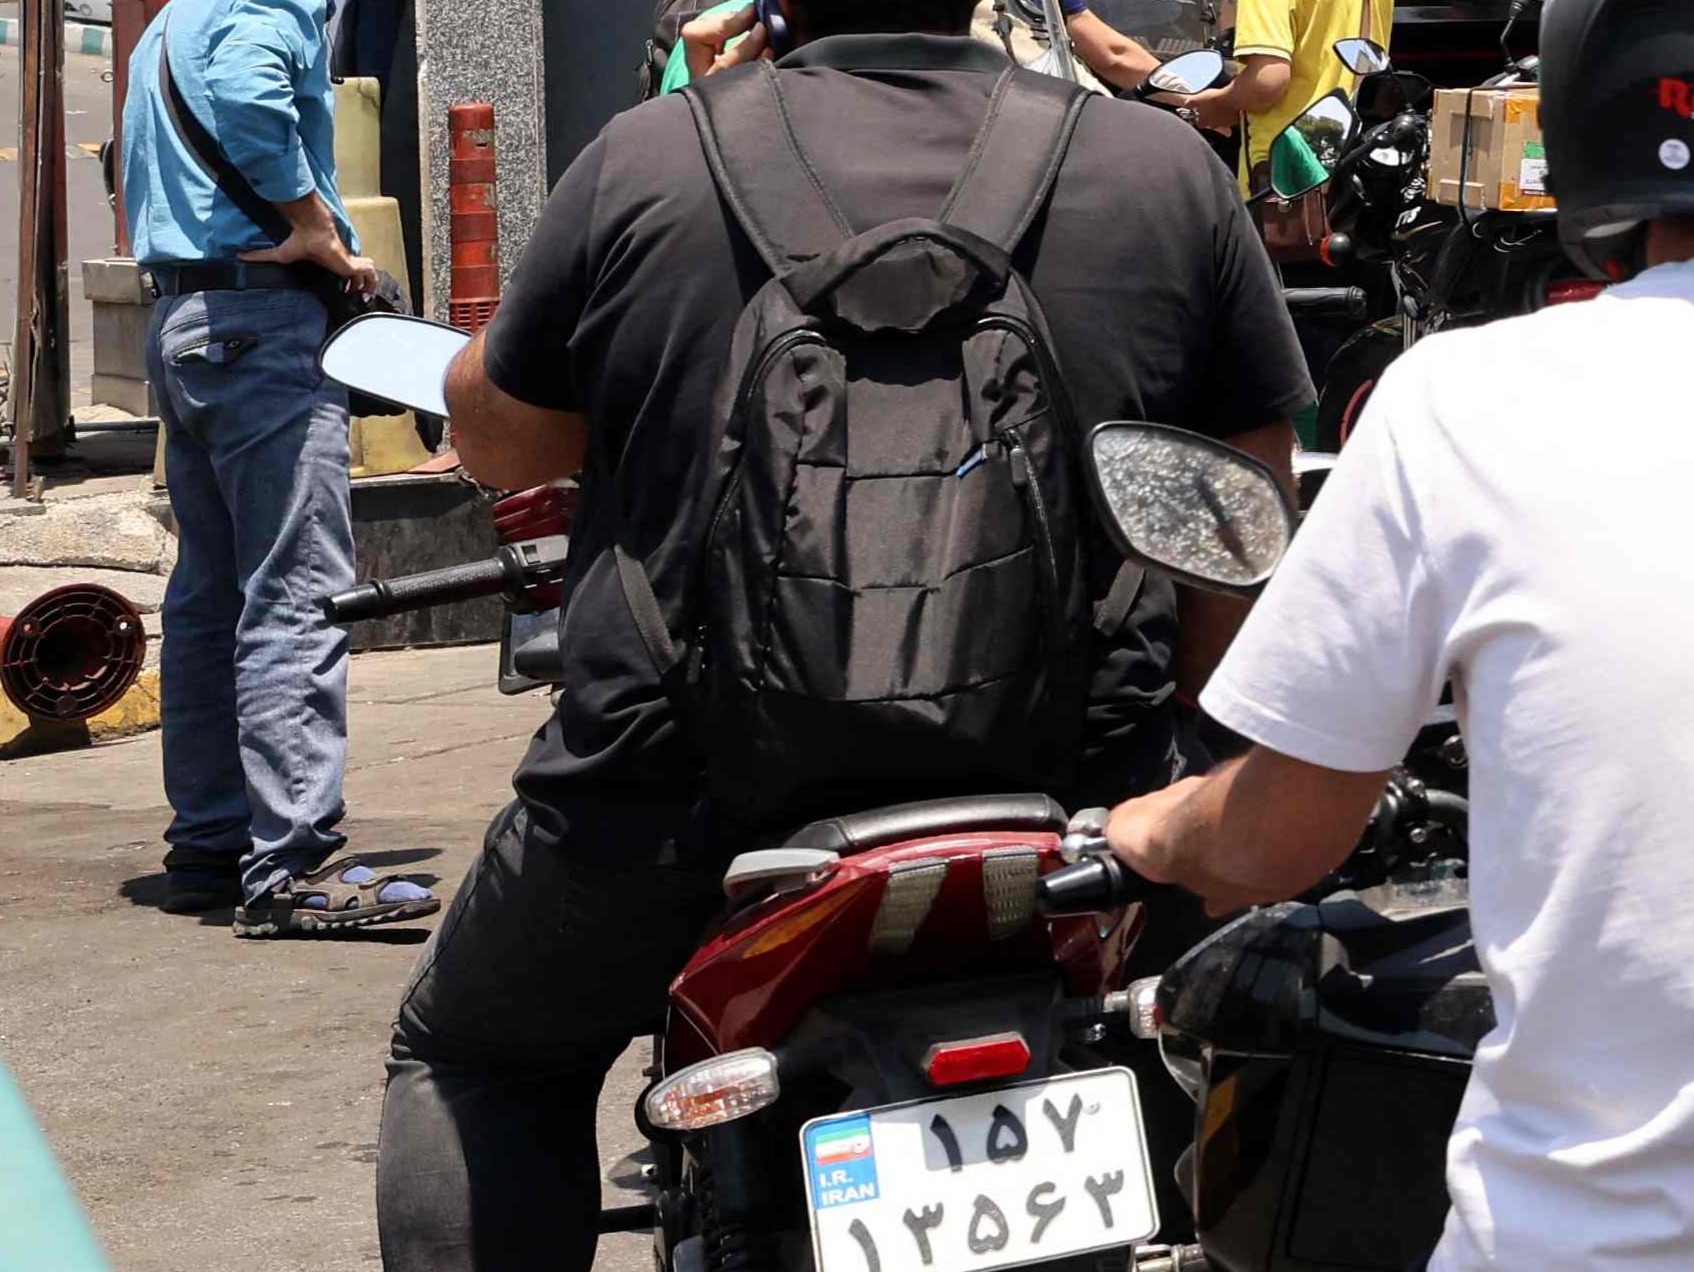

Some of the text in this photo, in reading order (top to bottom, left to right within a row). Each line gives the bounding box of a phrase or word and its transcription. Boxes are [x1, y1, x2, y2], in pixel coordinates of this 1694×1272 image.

[930, 1092, 1083, 1174] ۱۵۷
[819, 1167, 855, 1190] I.R.
[820, 1180, 876, 1208] IRAN
